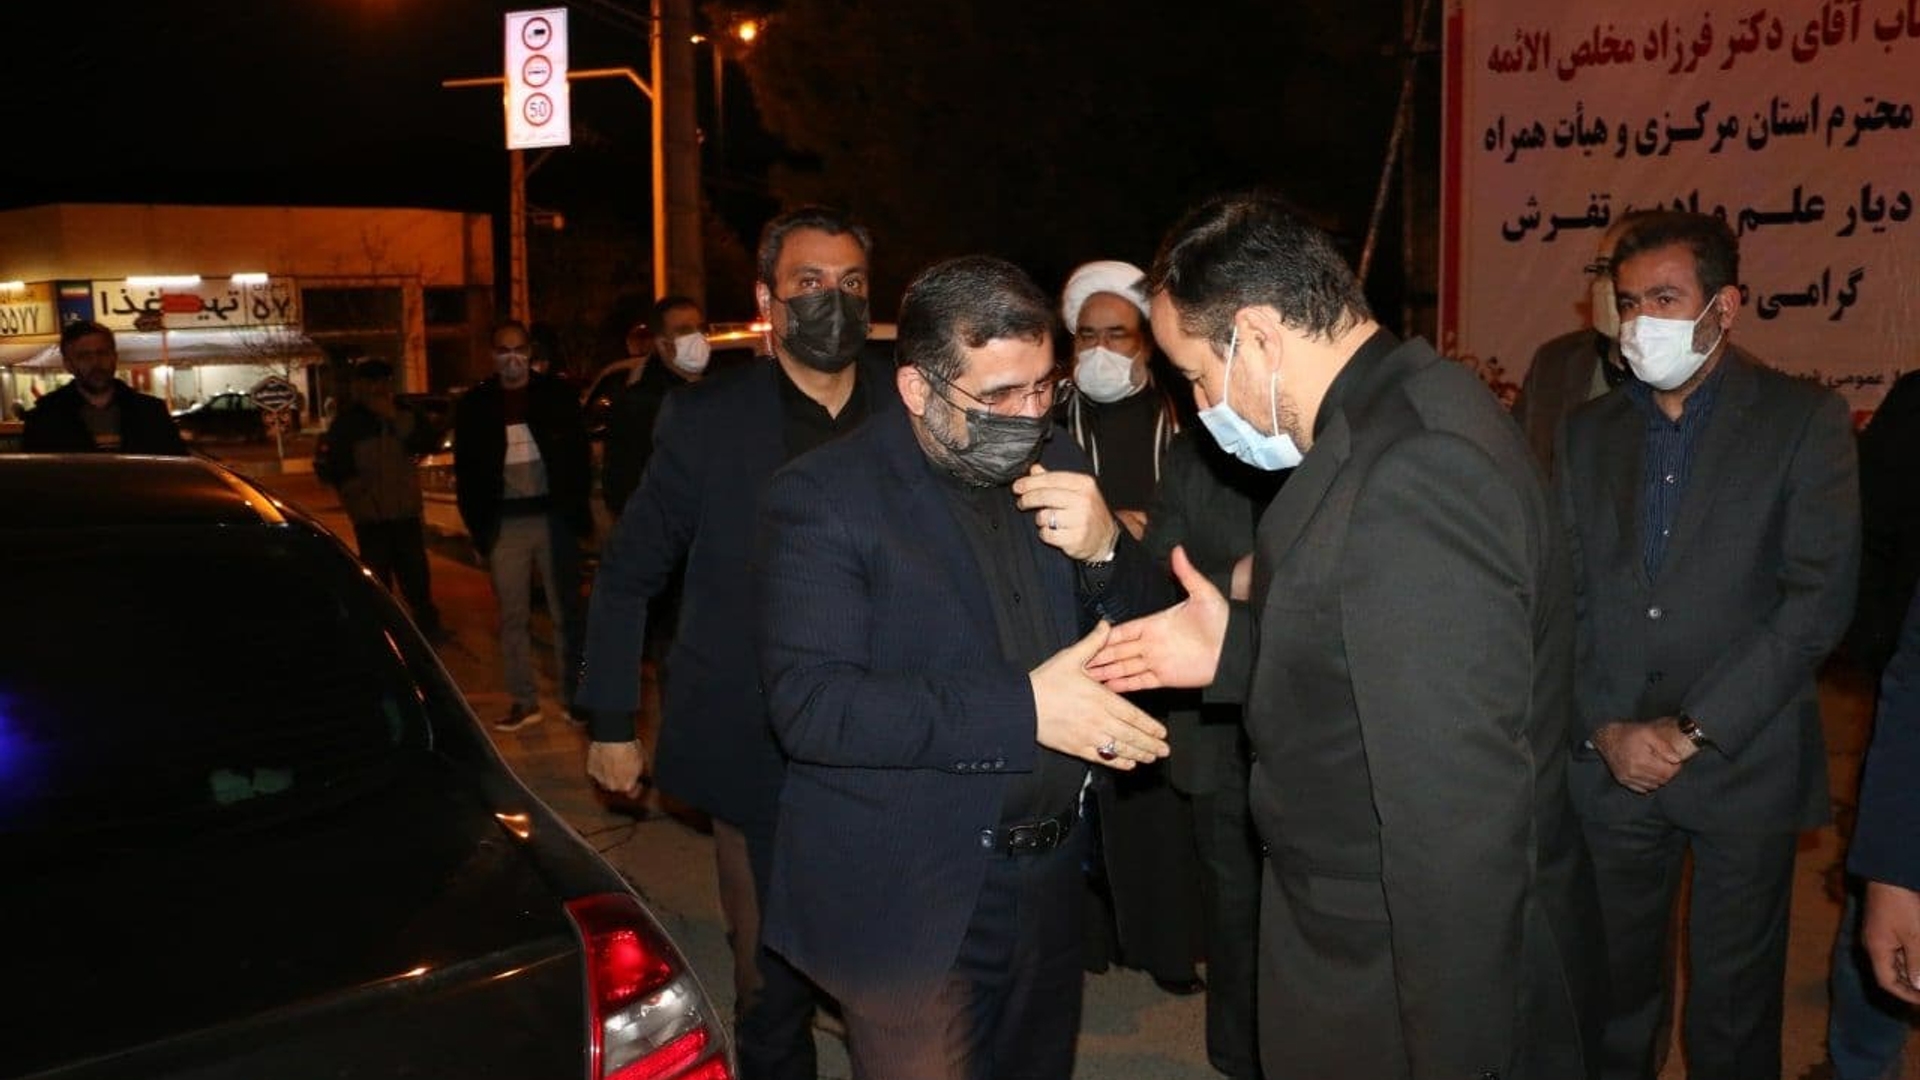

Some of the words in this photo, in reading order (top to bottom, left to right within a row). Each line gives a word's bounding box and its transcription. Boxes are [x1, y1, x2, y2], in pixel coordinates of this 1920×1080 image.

[1557, 24, 1635, 81] مخلص
[1643, 11, 1713, 74] فرزاد
[1720, 8, 1783, 70] دکتر
[1791, 0, 1861, 63] آقای
[530, 101, 547, 118] 50
[1635, 101, 1739, 157] مرکزی
[1747, 93, 1820, 151] استان
[1823, 96, 1914, 148] محترم
[1484, 115, 1546, 163] همراه
[1615, 122, 1628, 159] و
[1502, 193, 1611, 242] تفرش
[1738, 185, 1825, 238] علم
[1836, 182, 1912, 237] دیار
[101, 289, 163, 316] غذا
[1757, 267, 1865, 321] گرامی
